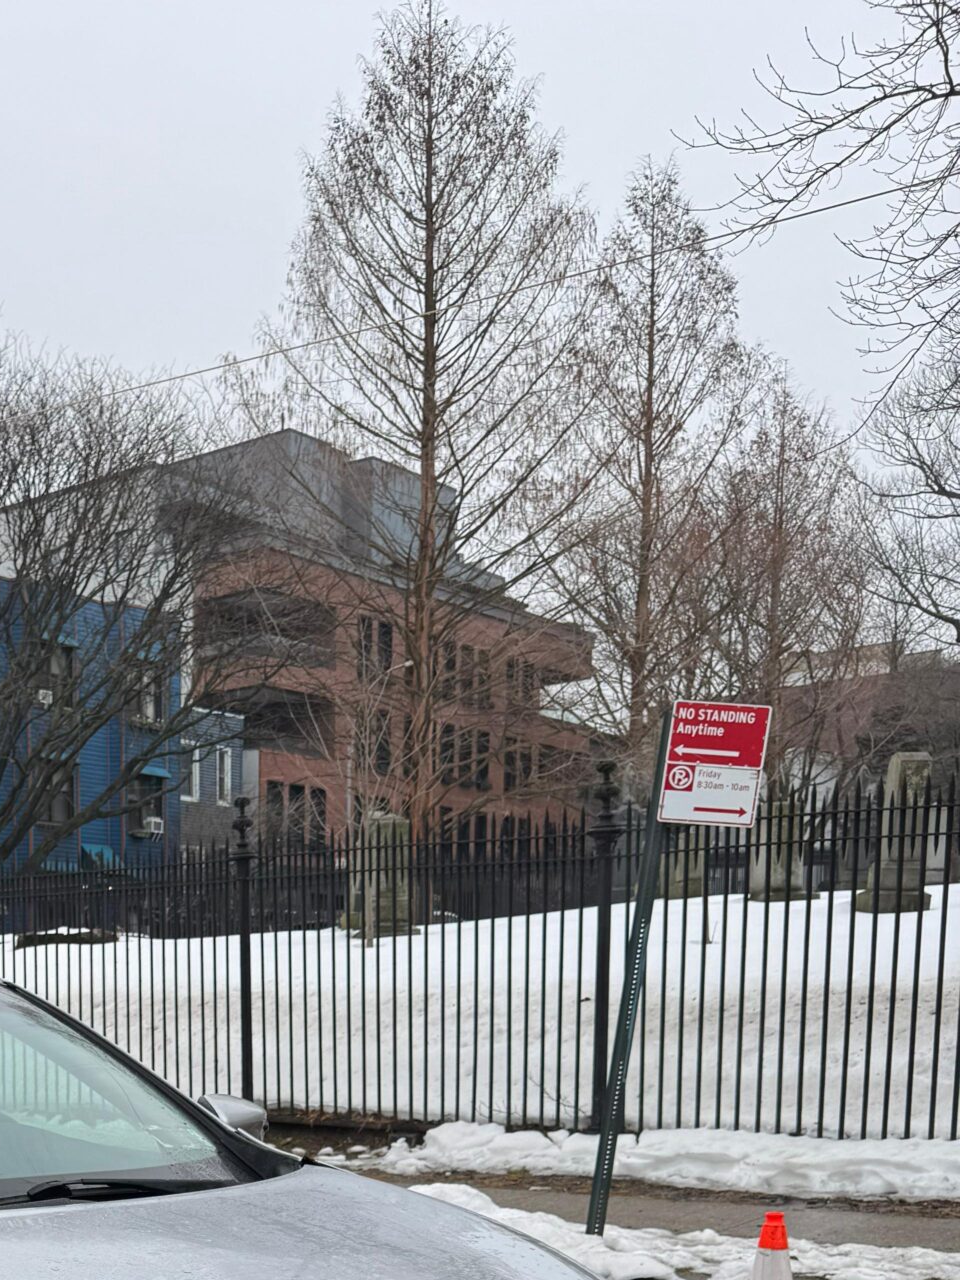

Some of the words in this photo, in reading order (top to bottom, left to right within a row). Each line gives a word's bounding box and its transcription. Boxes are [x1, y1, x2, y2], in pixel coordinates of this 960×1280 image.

[678, 707, 695, 720] NO
[697, 709, 756, 724] STANDING
[676, 722, 725, 737] Anytime
[698, 769, 722, 780] Friday
[696, 780, 725, 790] 8:30am
[731, 782, 750, 792] 10am
